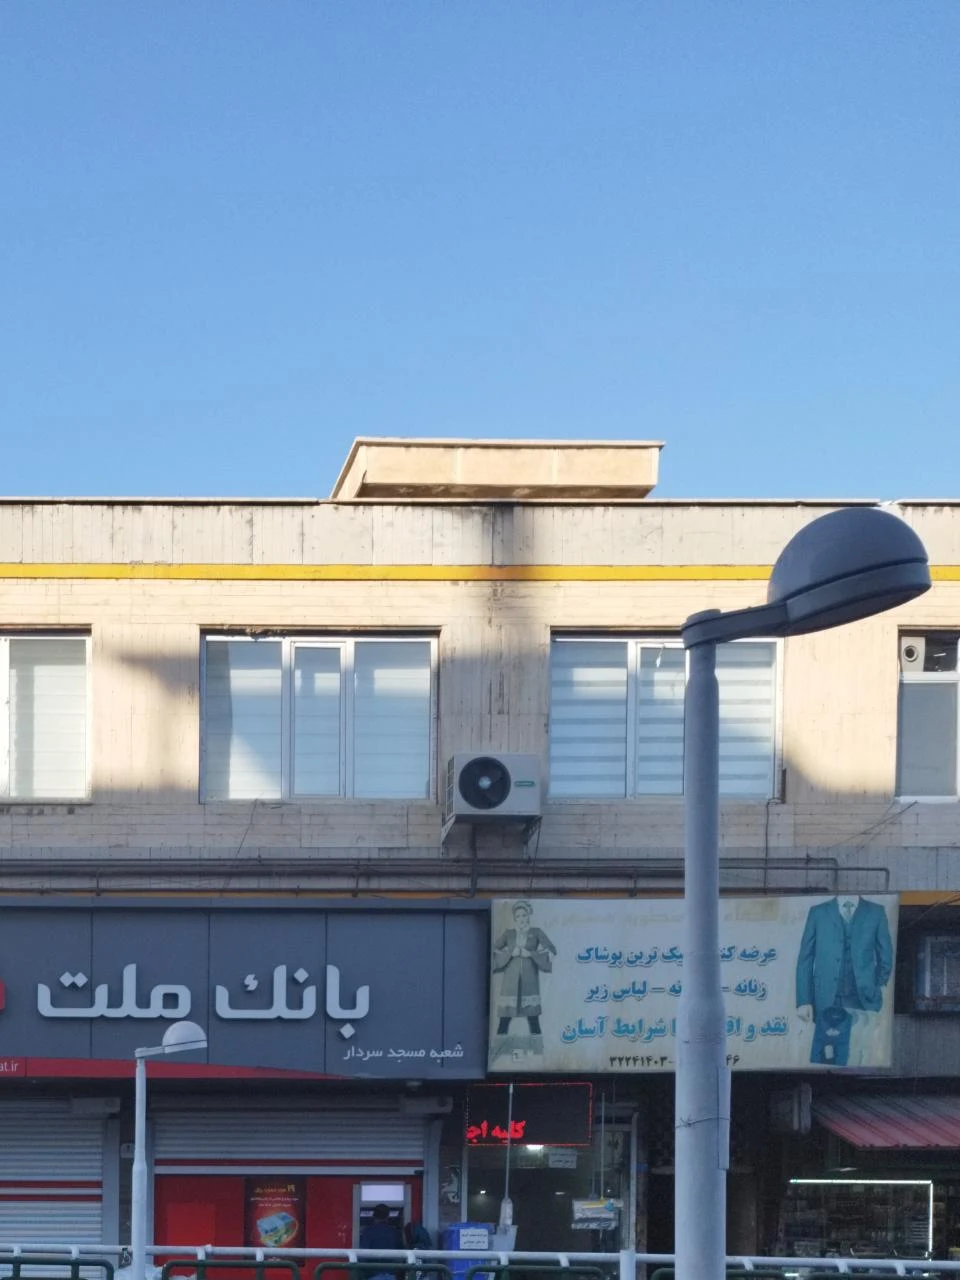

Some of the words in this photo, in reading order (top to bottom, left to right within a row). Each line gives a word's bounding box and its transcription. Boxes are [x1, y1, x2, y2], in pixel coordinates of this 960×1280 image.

[576, 945, 622, 967] پوشاک
[627, 946, 658, 966] ترین
[740, 945, 777, 965] عرضه
[37, 963, 192, 1019] ملت
[585, 983, 609, 1002] زیر
[612, 979, 647, 1000] لباس
[734, 977, 768, 999] زنانه
[560, 1015, 608, 1043] آسان
[611, 1016, 666, 1043] شرایط
[744, 1021, 756, 1041] و
[760, 1015, 790, 1036] نقد
[343, 1045, 383, 1061] سردار
[387, 1047, 426, 1063] مسجد
[430, 1043, 464, 1063] شعبه
